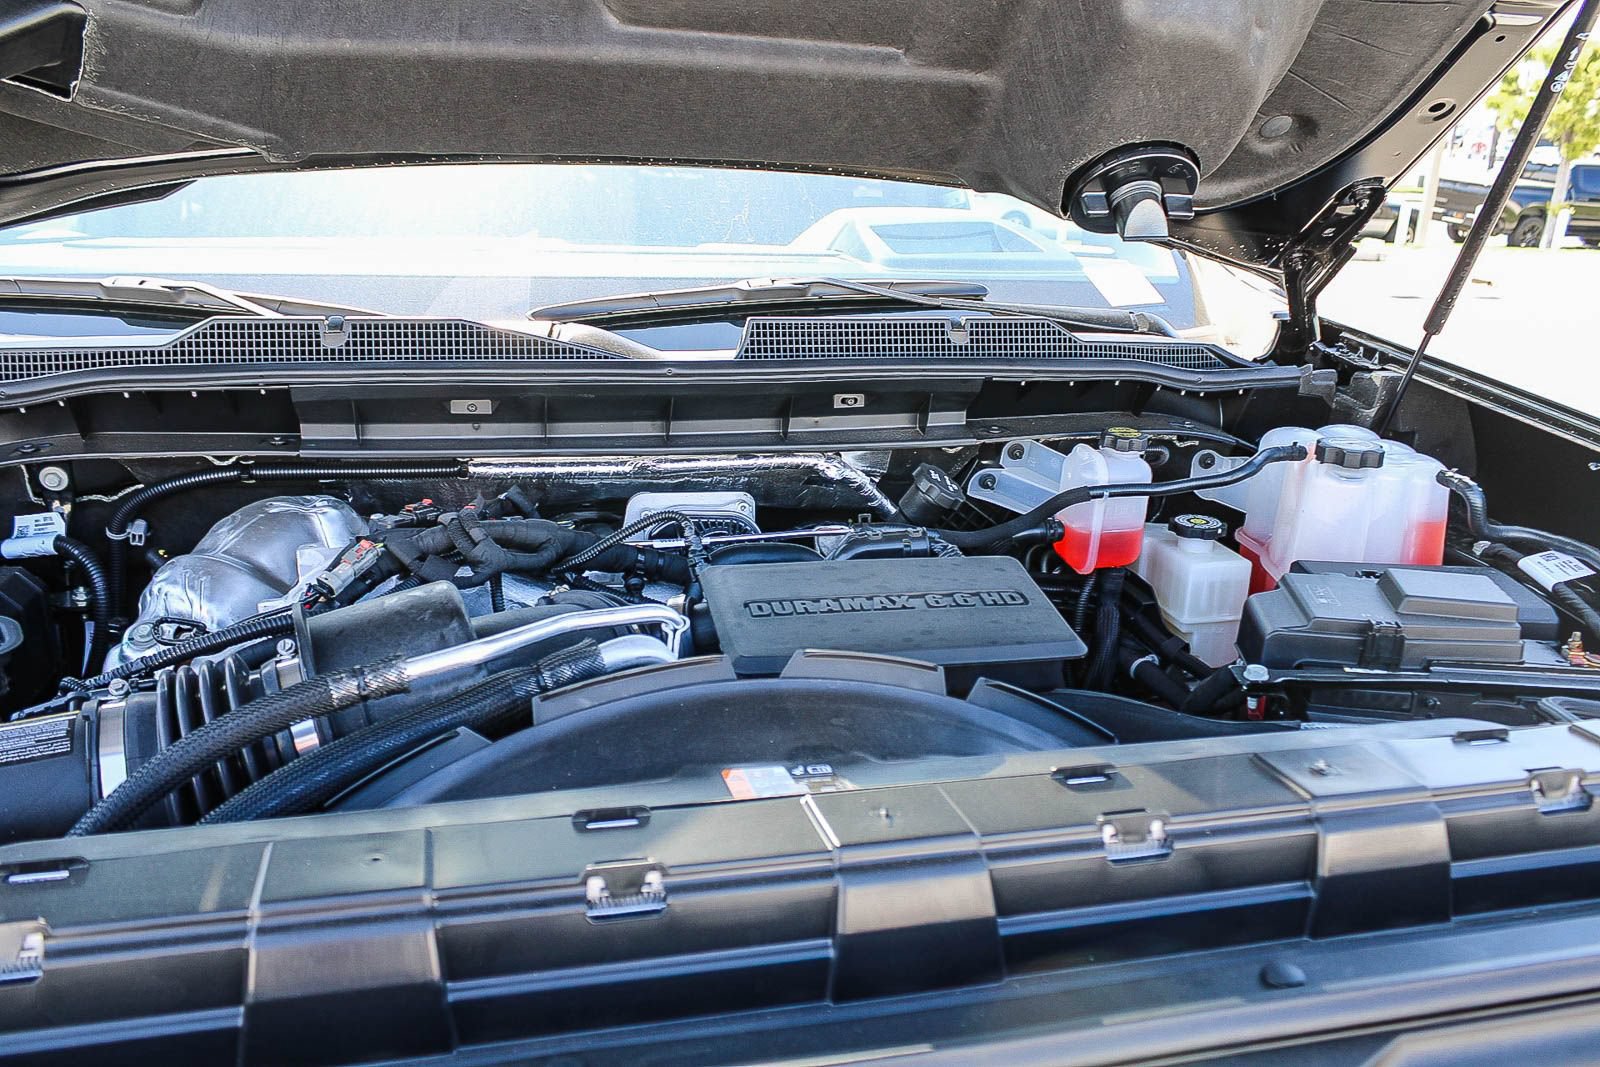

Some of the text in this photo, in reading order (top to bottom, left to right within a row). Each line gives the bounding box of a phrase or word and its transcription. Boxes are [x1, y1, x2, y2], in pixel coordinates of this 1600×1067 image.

[749, 591, 1026, 617] DURAMAX 6.6 HD
